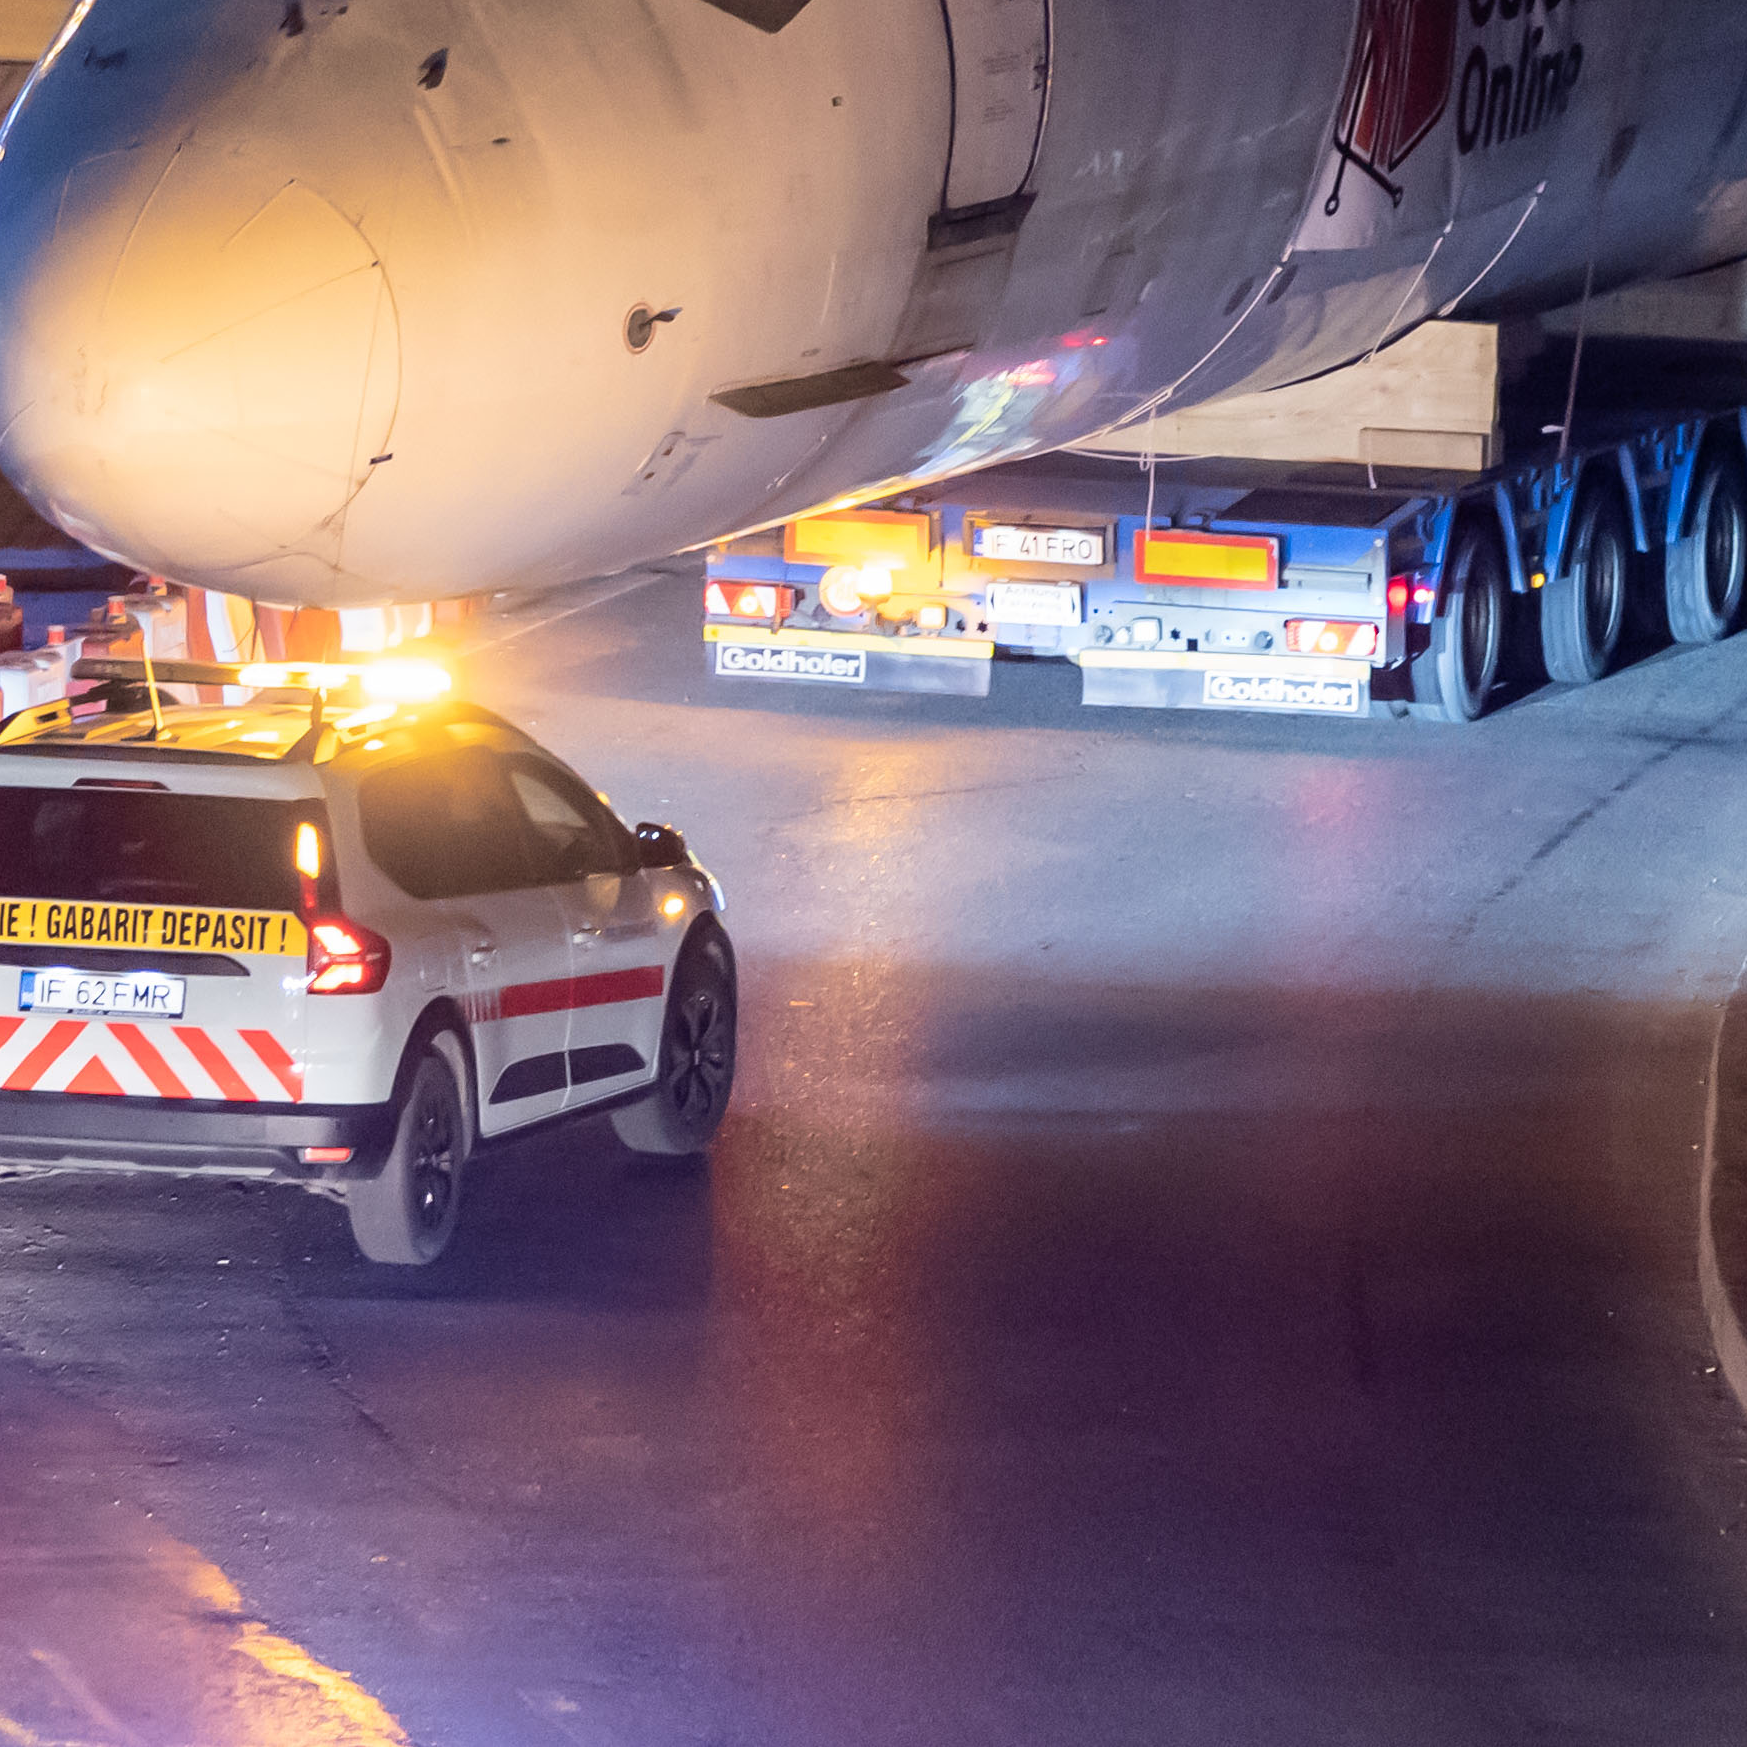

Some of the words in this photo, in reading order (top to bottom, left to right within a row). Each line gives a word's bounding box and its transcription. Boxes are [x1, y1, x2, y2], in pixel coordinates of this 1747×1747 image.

[1019, 535, 1038, 556] 41
[1046, 536, 1093, 560] FRO
[722, 647, 860, 677] Goldhofer
[1210, 676, 1353, 706] Goldhofer
[46, 904, 153, 944] GABARIT
[161, 910, 271, 952] DEPASIT
[40, 979, 66, 1004] IF
[76, 980, 107, 1006] 62
[113, 981, 171, 1010] FMR
